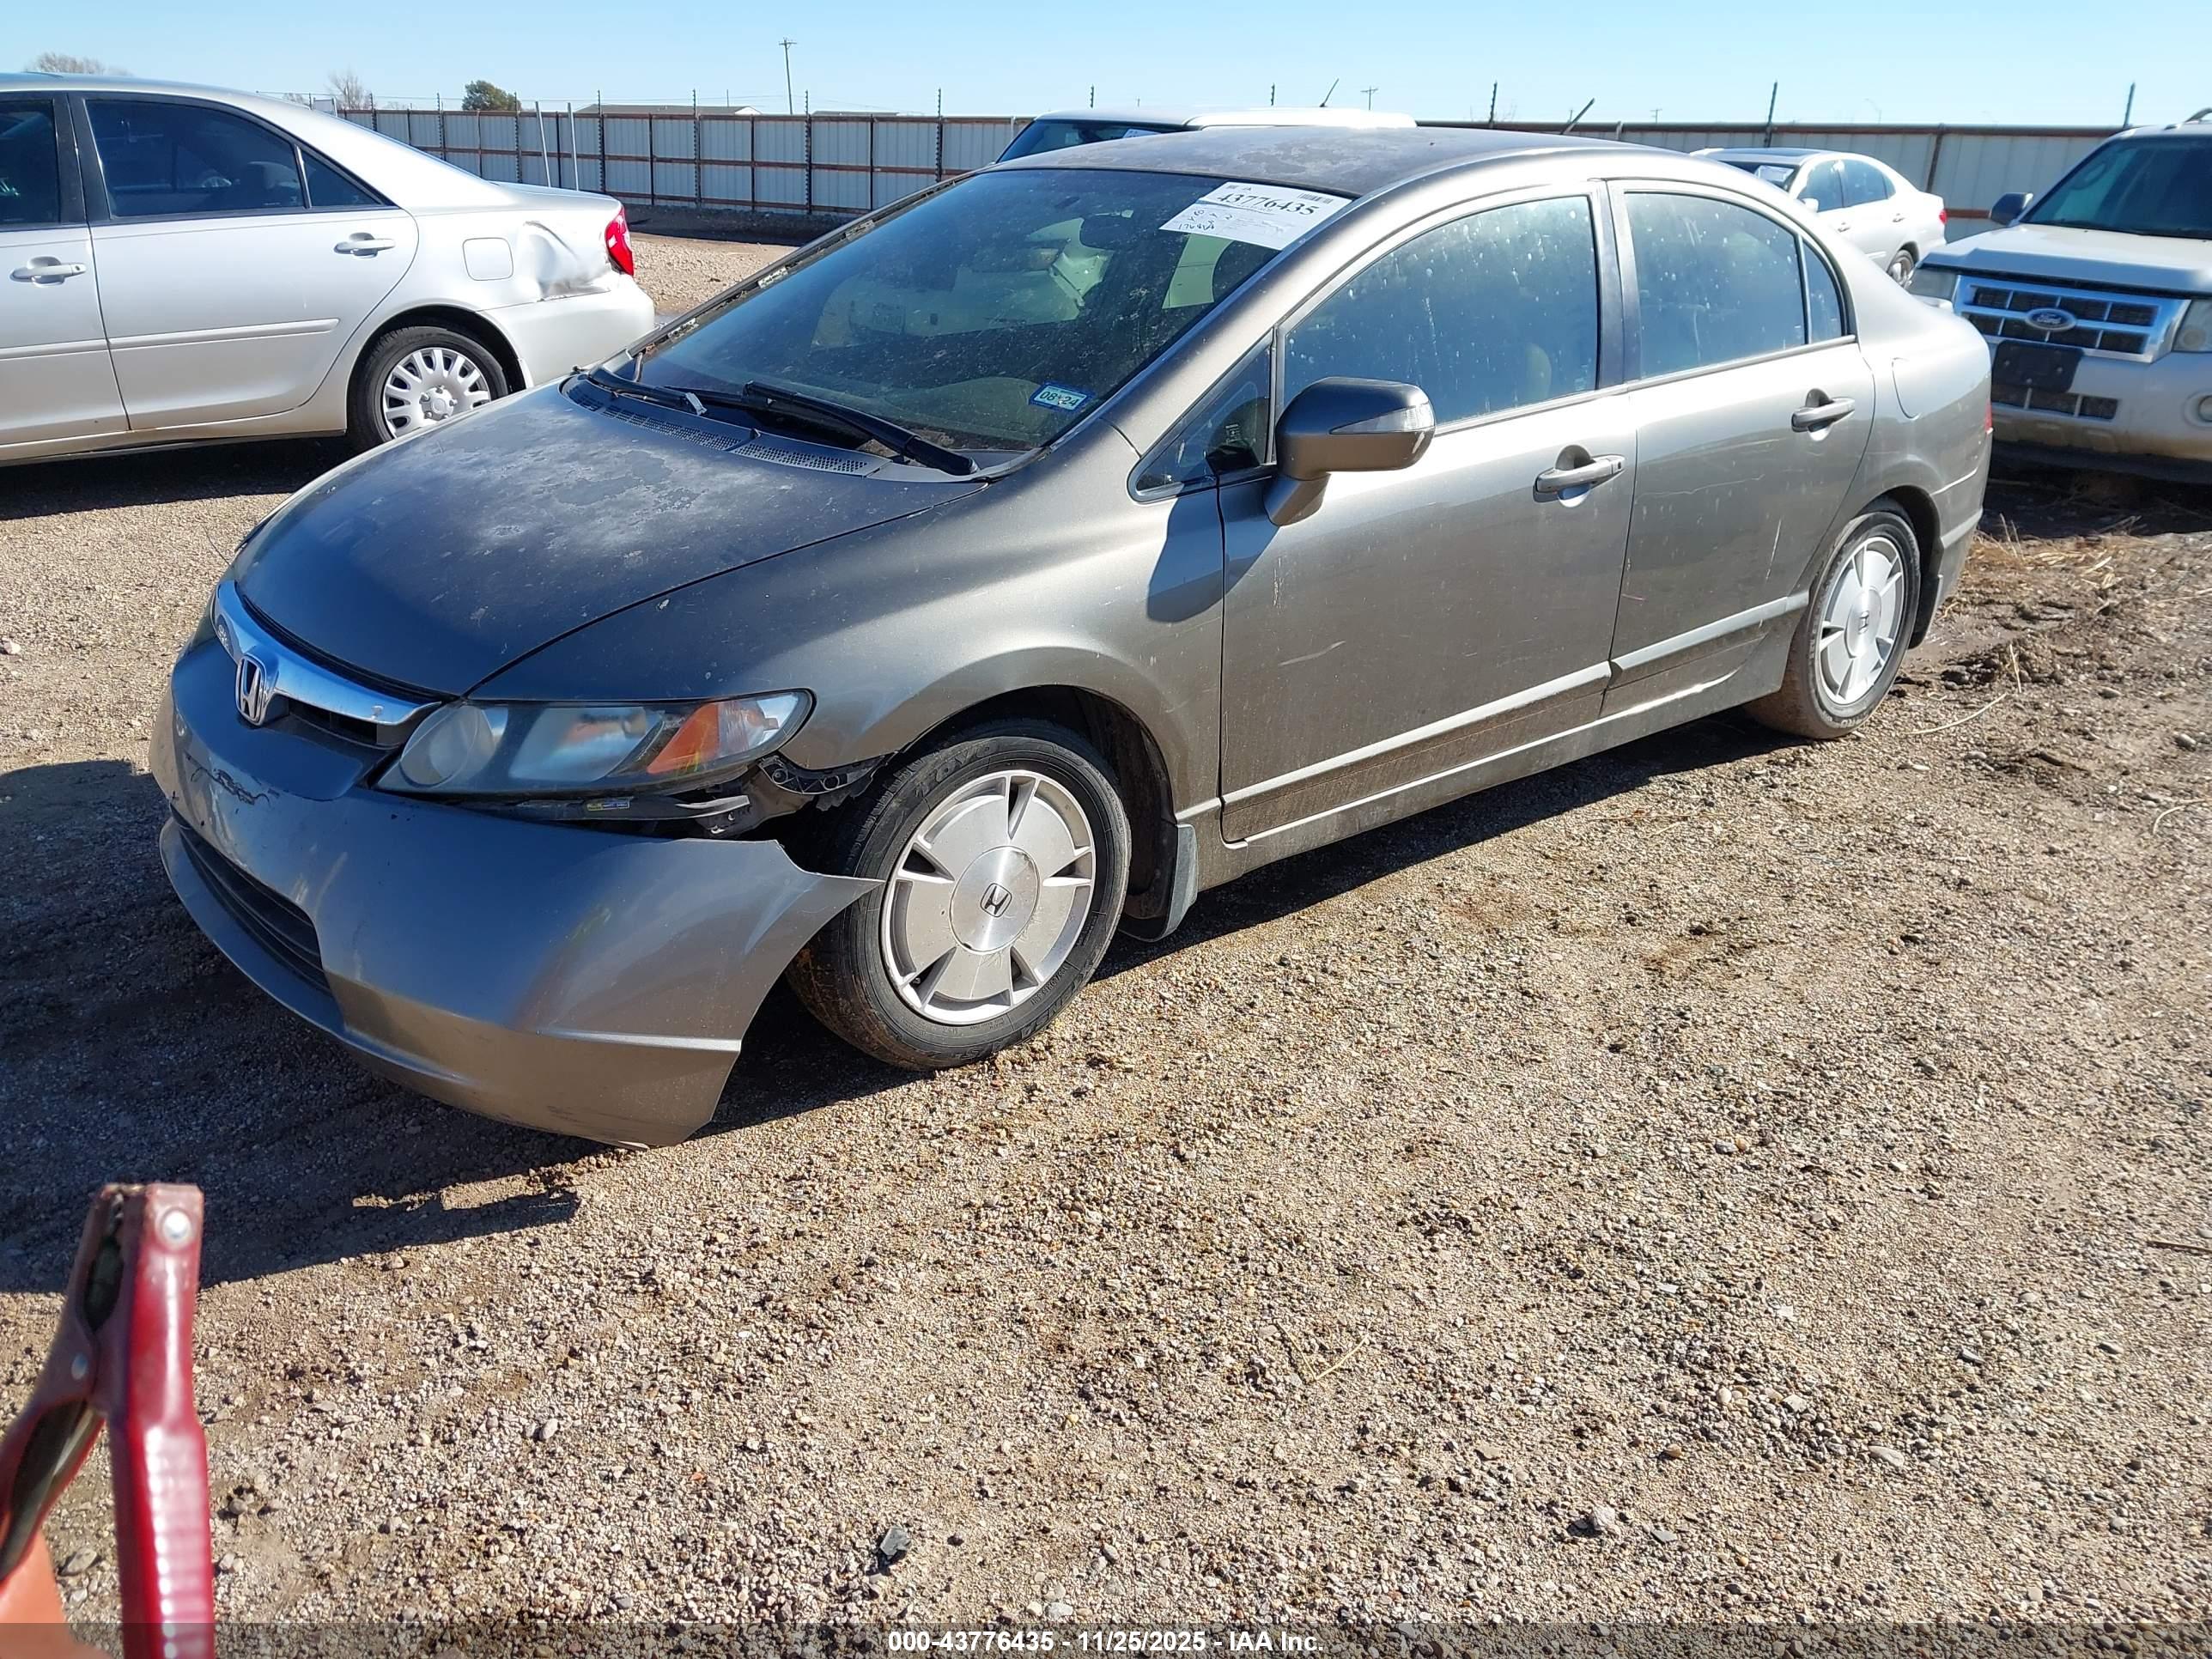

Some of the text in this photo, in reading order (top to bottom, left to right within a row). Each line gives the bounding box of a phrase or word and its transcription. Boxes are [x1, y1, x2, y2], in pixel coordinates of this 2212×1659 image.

[1218, 192, 1320, 216] 43776435
[1039, 391, 1058, 401] 08
[1060, 396, 1079, 407] 24
